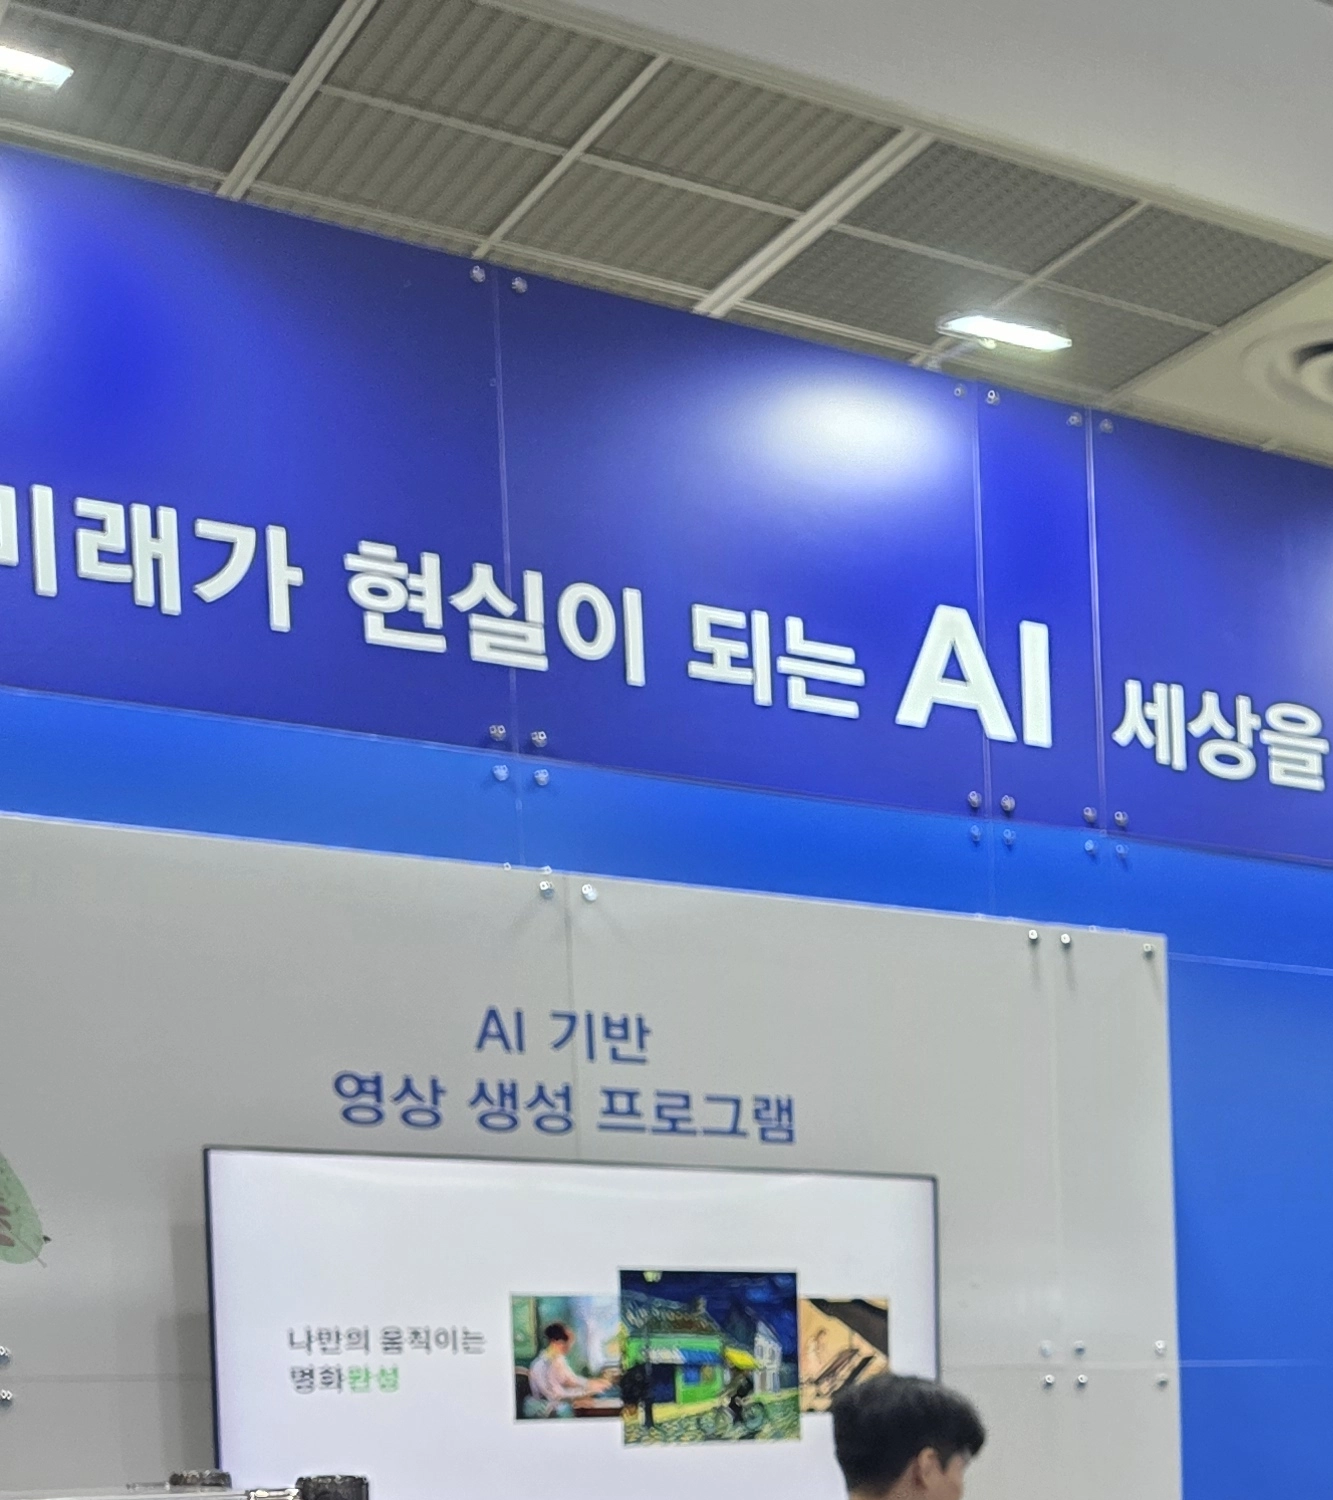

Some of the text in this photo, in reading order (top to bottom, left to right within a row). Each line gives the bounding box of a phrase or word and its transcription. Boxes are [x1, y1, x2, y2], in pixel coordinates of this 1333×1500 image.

[343, 540, 646, 687] 현실이
[687, 604, 866, 720] 되는
[896, 604, 1053, 748] AI
[1113, 680, 1330, 791] 세상을
[475, 1005, 652, 1064] AI 기반
[333, 1071, 796, 1144] 영상 생성 프로그램
[288, 1325, 486, 1356] 나만의 움직이는
